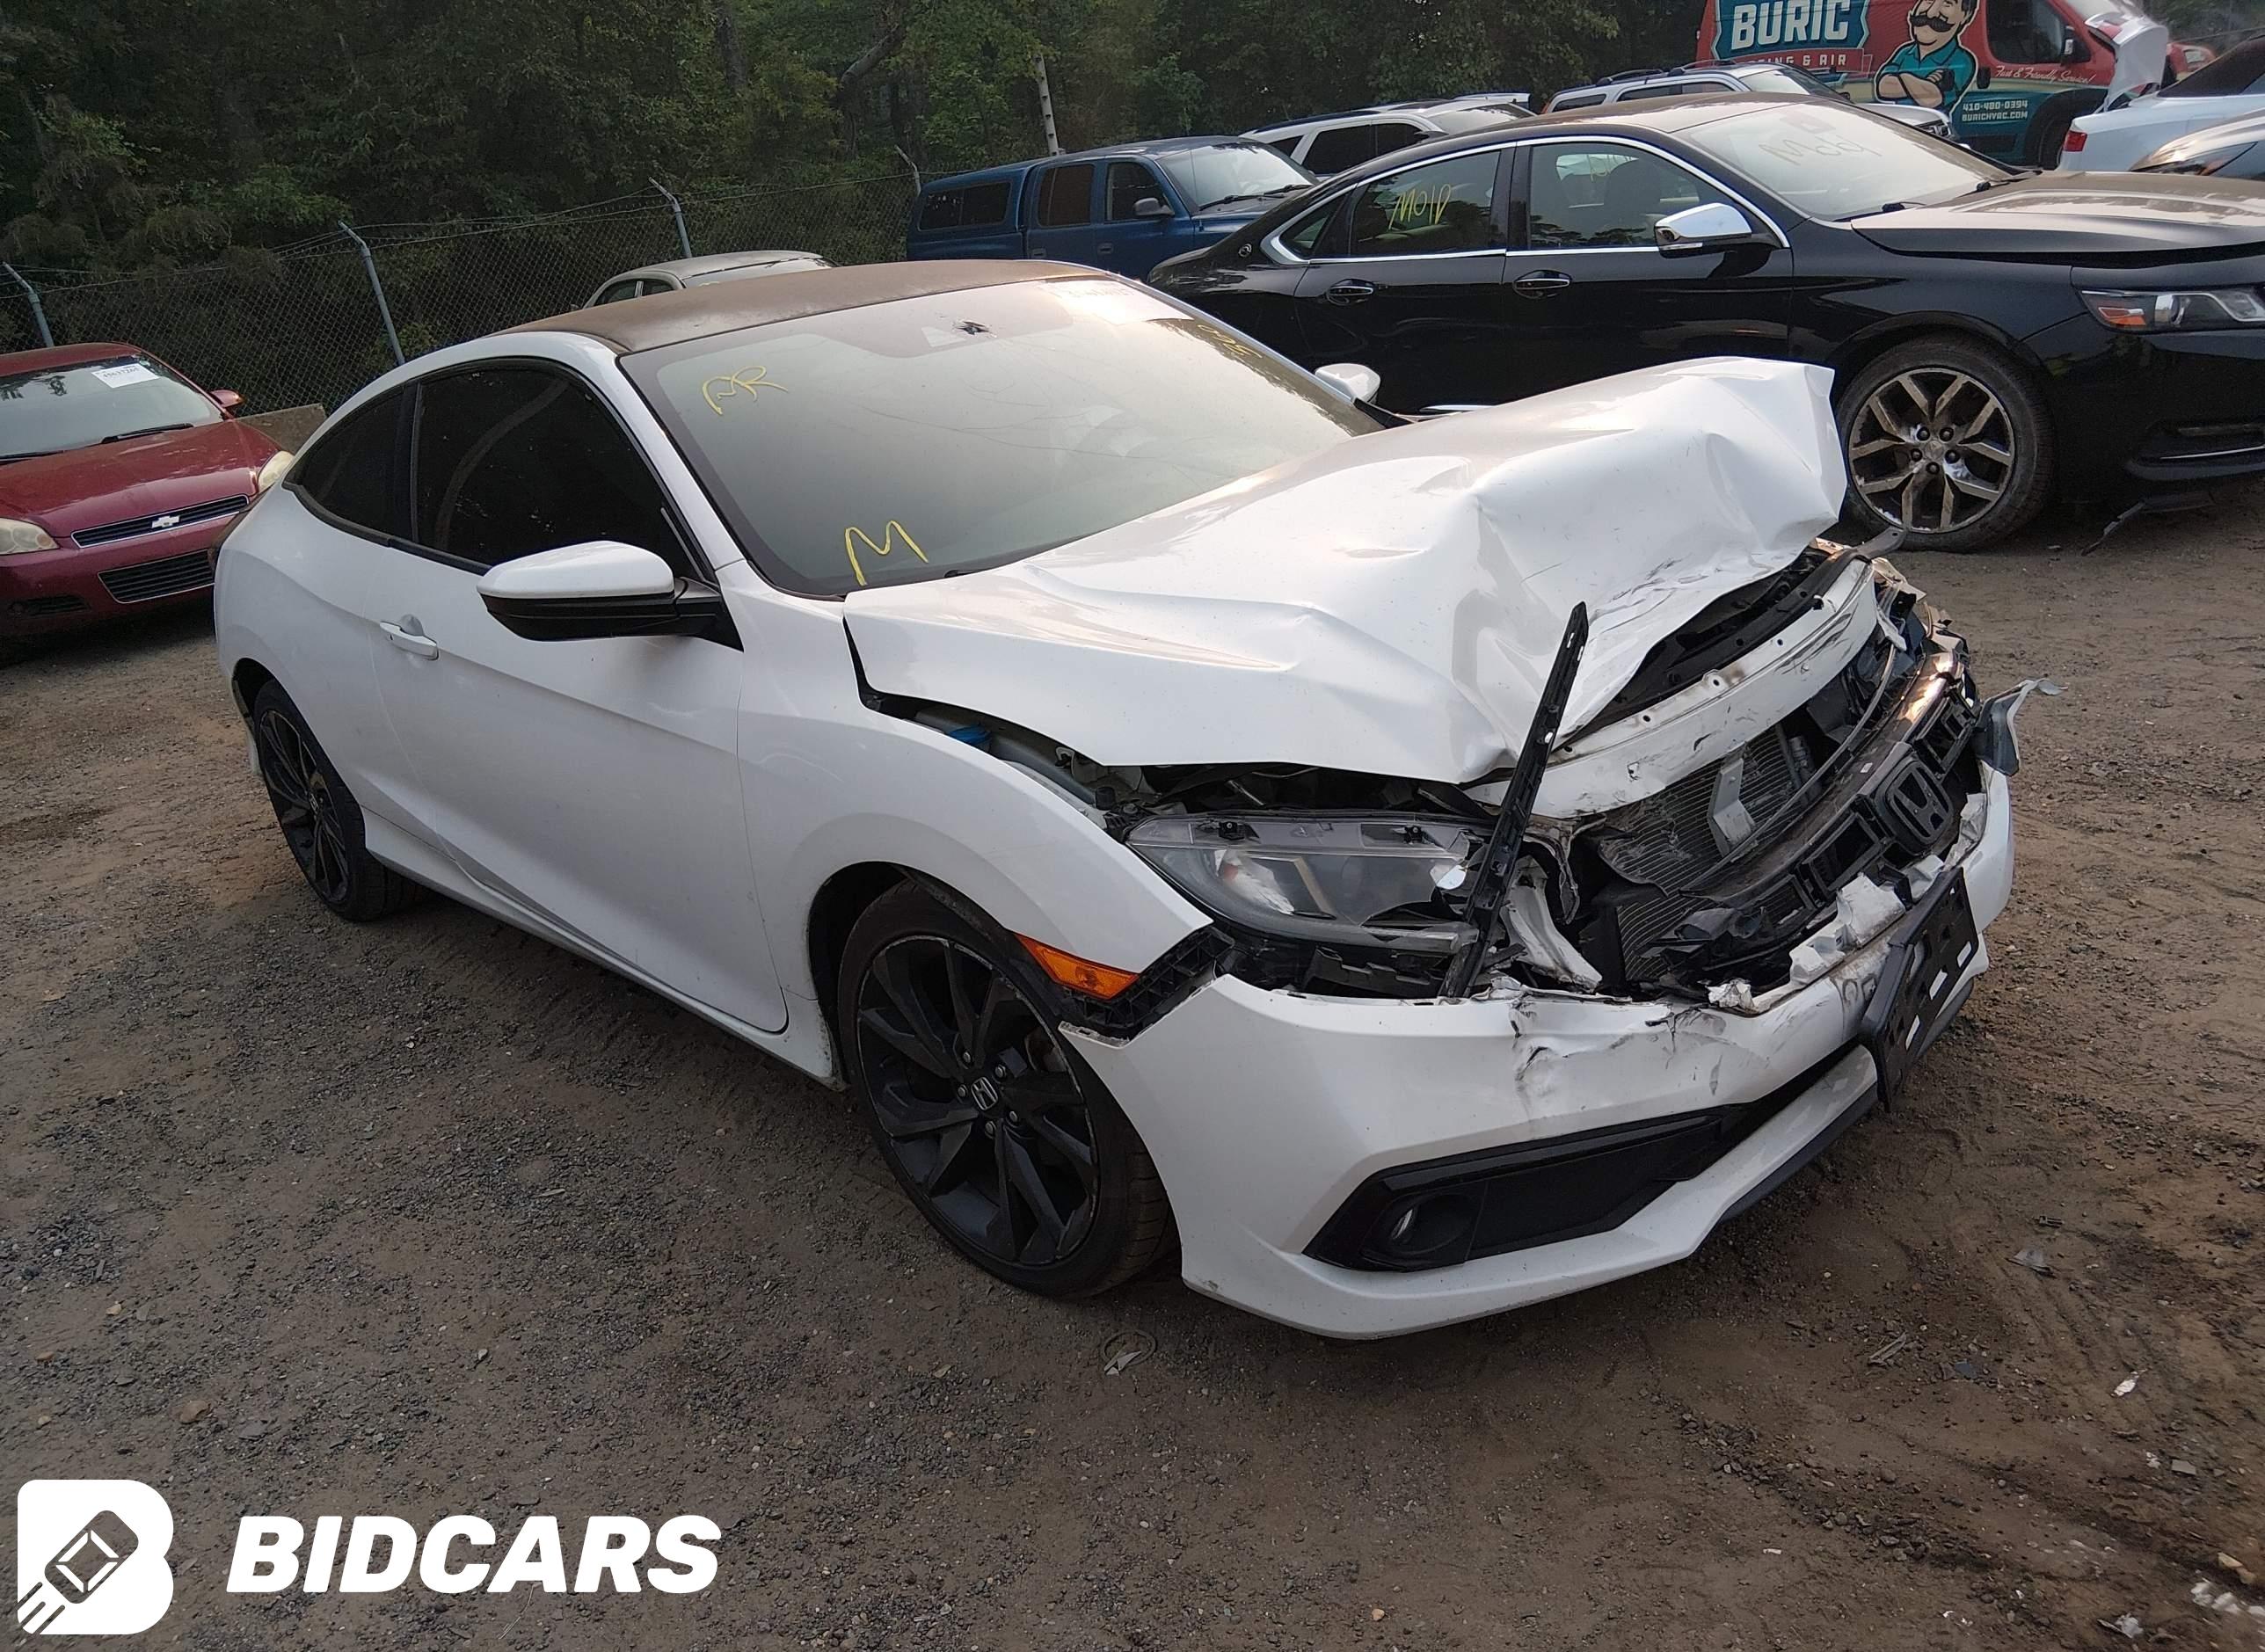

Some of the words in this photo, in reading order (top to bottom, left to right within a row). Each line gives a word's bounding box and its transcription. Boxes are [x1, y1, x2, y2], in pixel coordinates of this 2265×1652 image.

[1731, 0, 1850, 50] BURIC
[1819, 54, 1846, 66] AIR
[1962, 111, 2028, 121] BURICHVAC.COM
[845, 520, 929, 586] M
